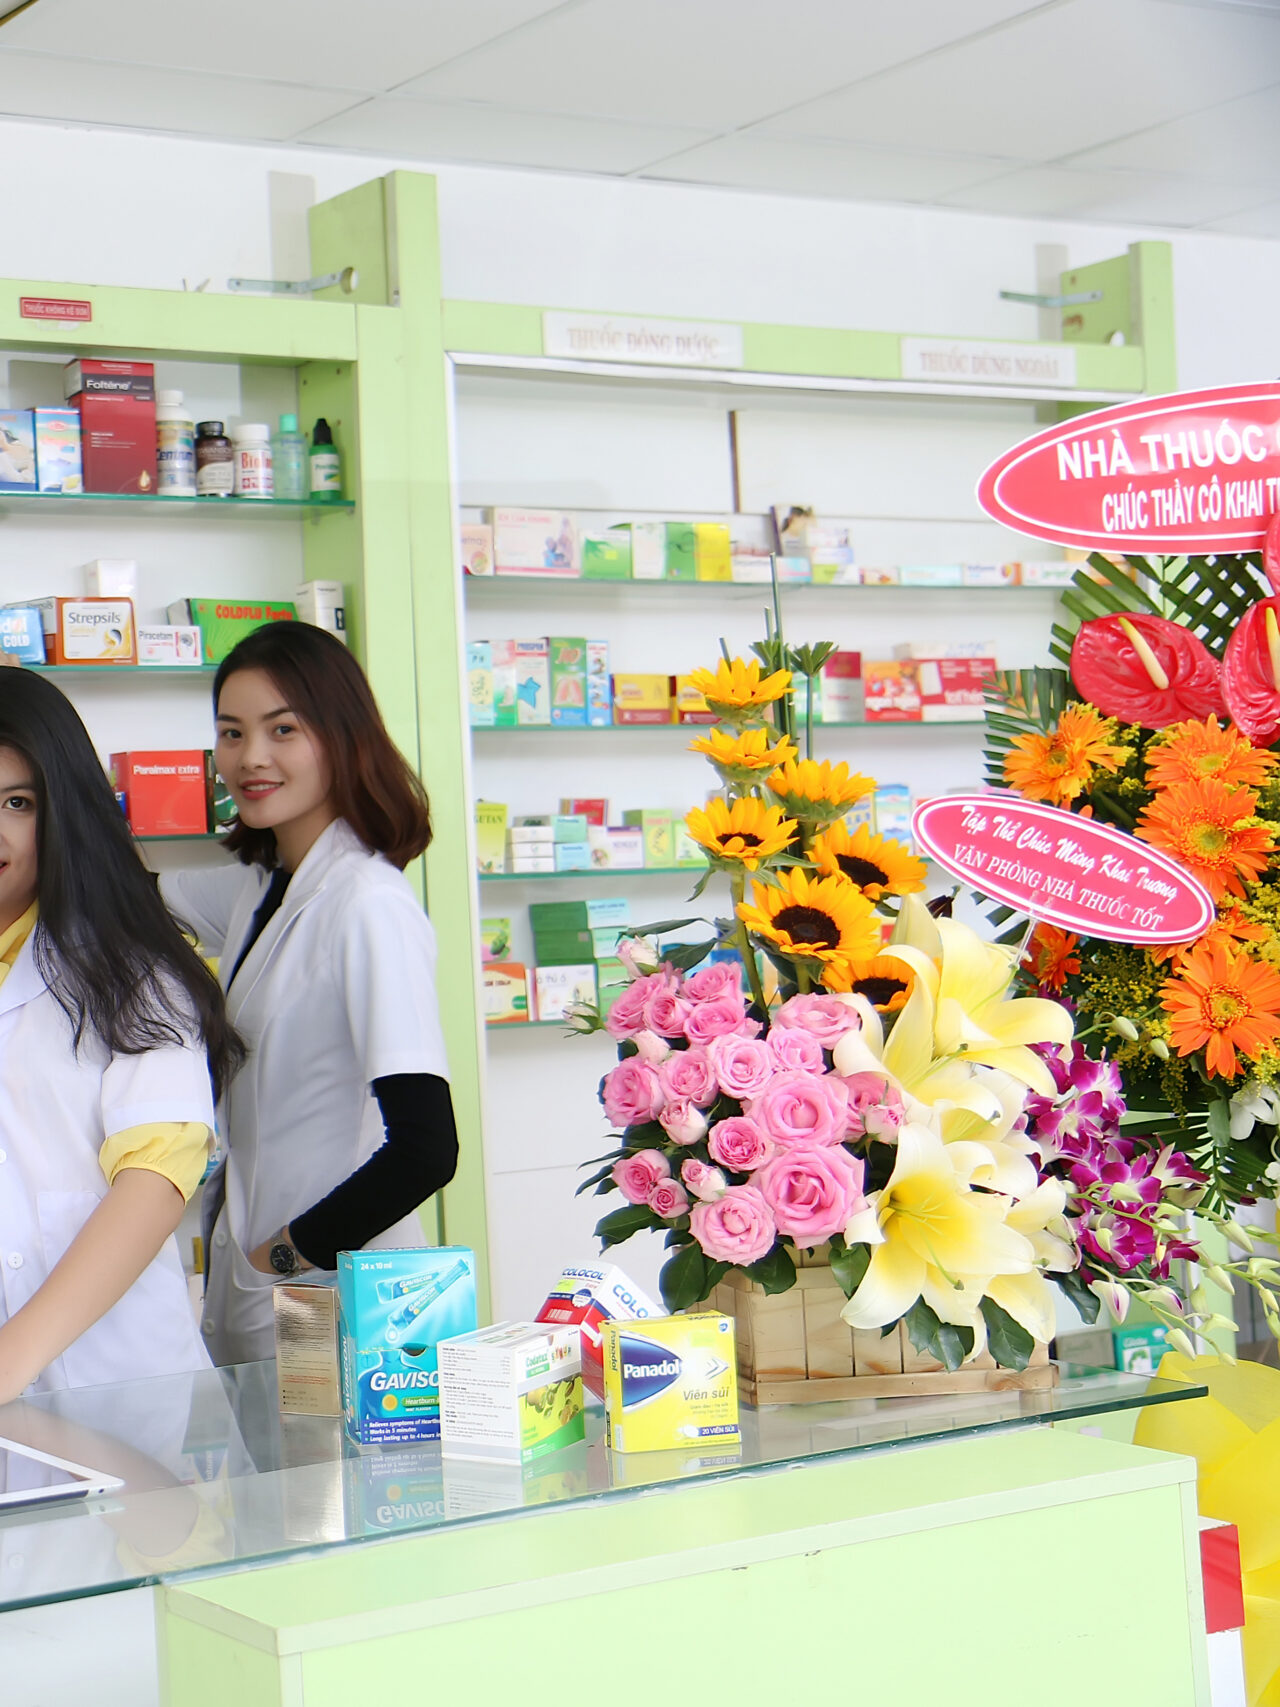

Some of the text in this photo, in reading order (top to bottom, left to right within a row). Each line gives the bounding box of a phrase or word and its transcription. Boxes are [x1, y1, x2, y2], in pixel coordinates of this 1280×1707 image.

[1056, 418, 1267, 480] NHÀ THUỐC
[1102, 475, 1263, 532] CHÚC THẦY CÔ KHAI
[68, 611, 121, 626] Strepsils
[215, 604, 262, 620] COLDFLU
[3, 635, 30, 647] COLD
[961, 805, 987, 836] Tập
[992, 815, 1022, 842] Thể
[1016, 825, 1051, 856] Chúc
[1100, 854, 1134, 883] Khai
[952, 844, 1164, 931] VĂN PHÒNG NHÀ THUỐC TỐT
[562, 1268, 606, 1280] COLOCOL
[612, 1283, 649, 1319] COLO
[610, 1330, 618, 1371] Panadol
[623, 1359, 680, 1379] Panadol
[370, 1371, 439, 1391] GAVISC
[683, 1388, 708, 1401] Viên
[710, 1425, 724, 1434] VIÊN
